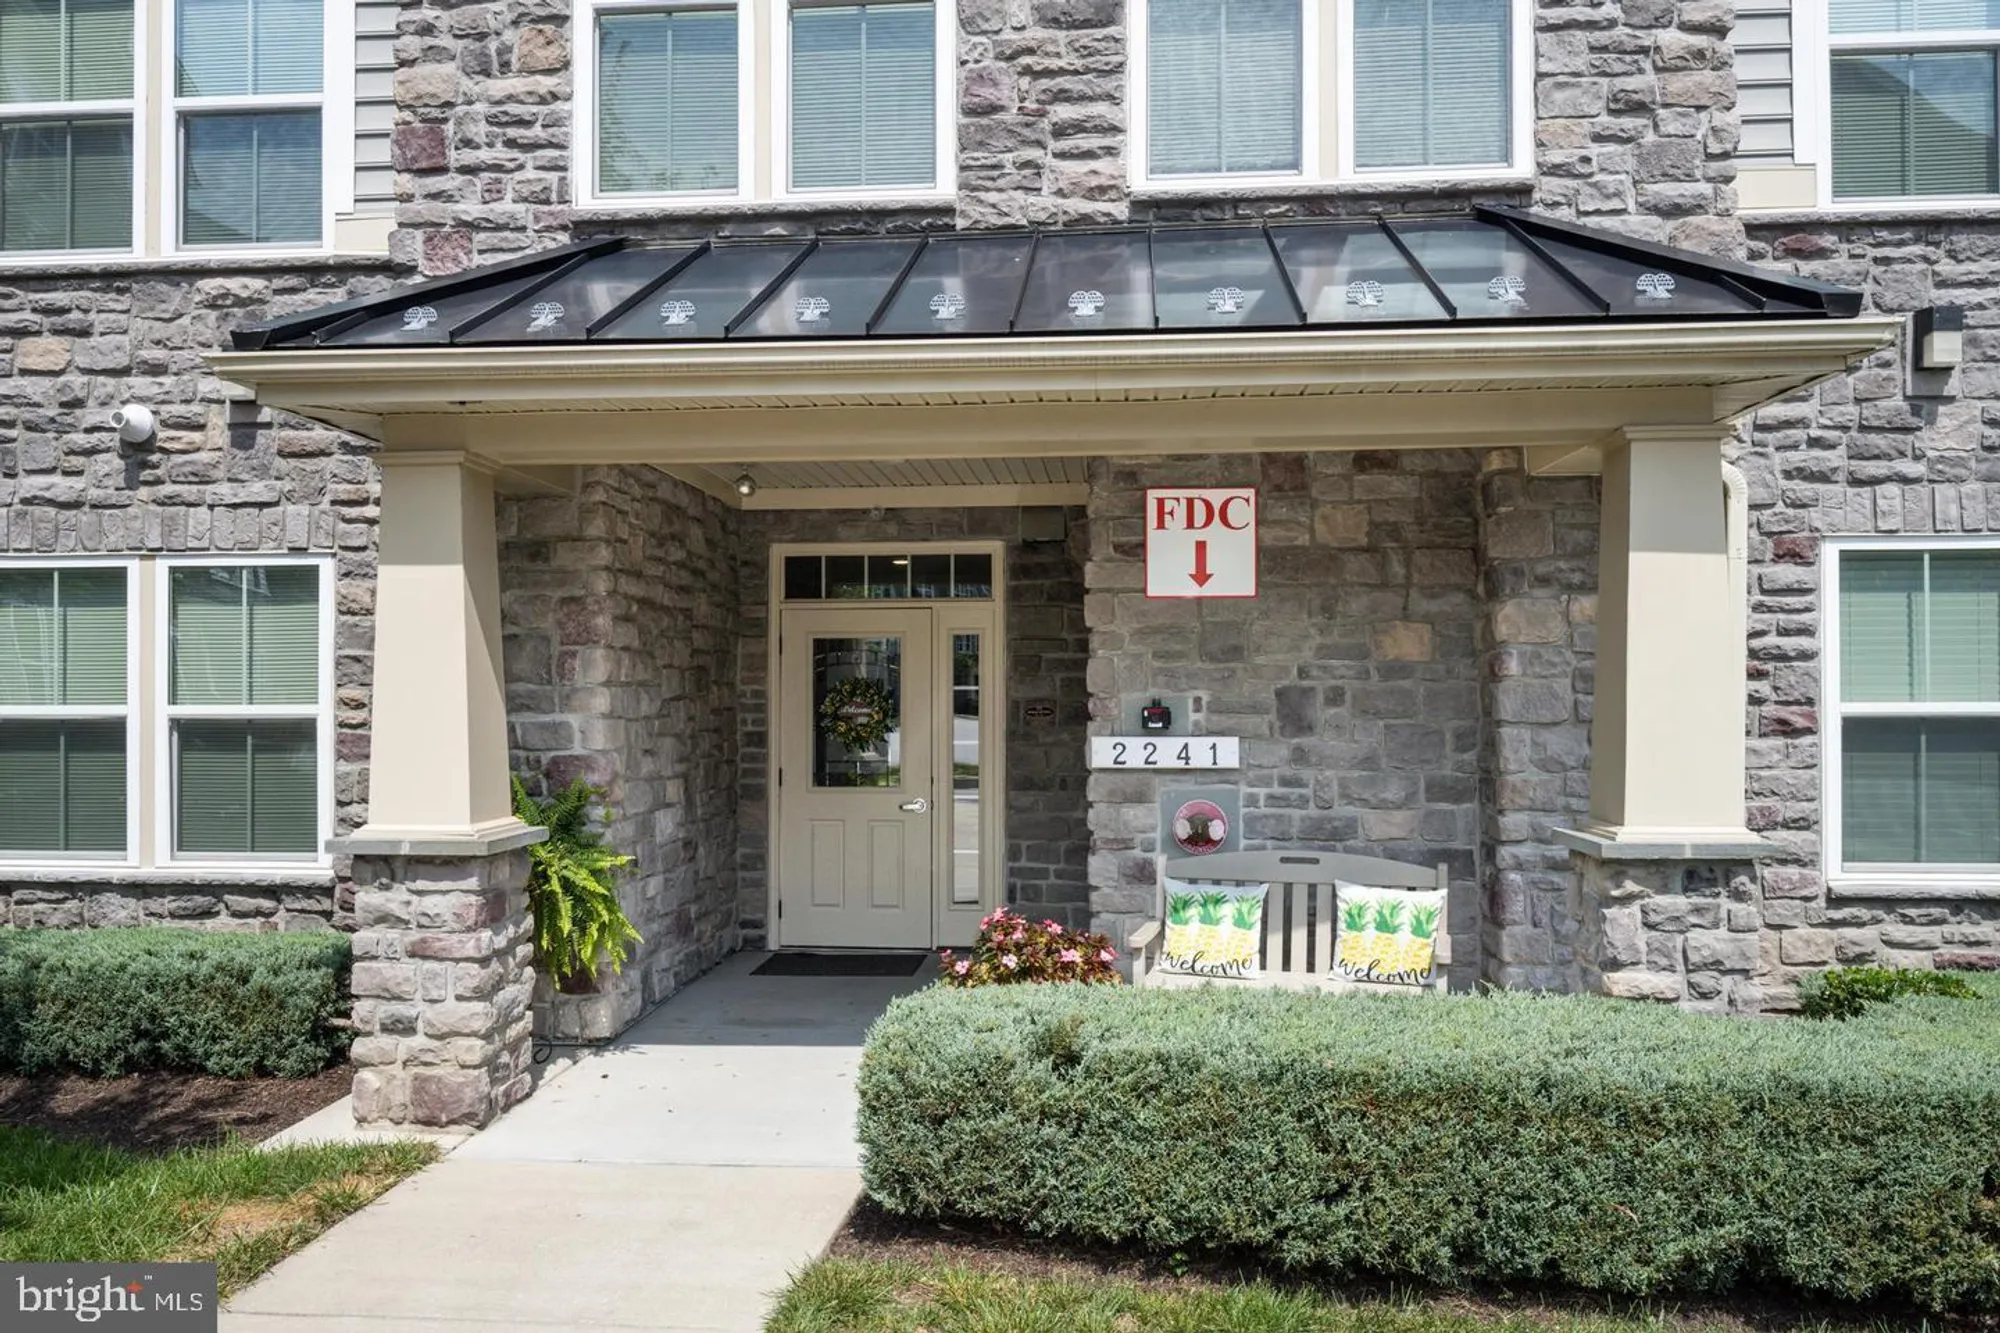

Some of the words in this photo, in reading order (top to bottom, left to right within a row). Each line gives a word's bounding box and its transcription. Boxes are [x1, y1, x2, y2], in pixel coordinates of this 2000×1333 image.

[1152, 495, 1250, 531] FDC
[1112, 742, 1220, 766] 2241
[1165, 950, 1253, 977] welcome
[1338, 957, 1432, 984] welcome
